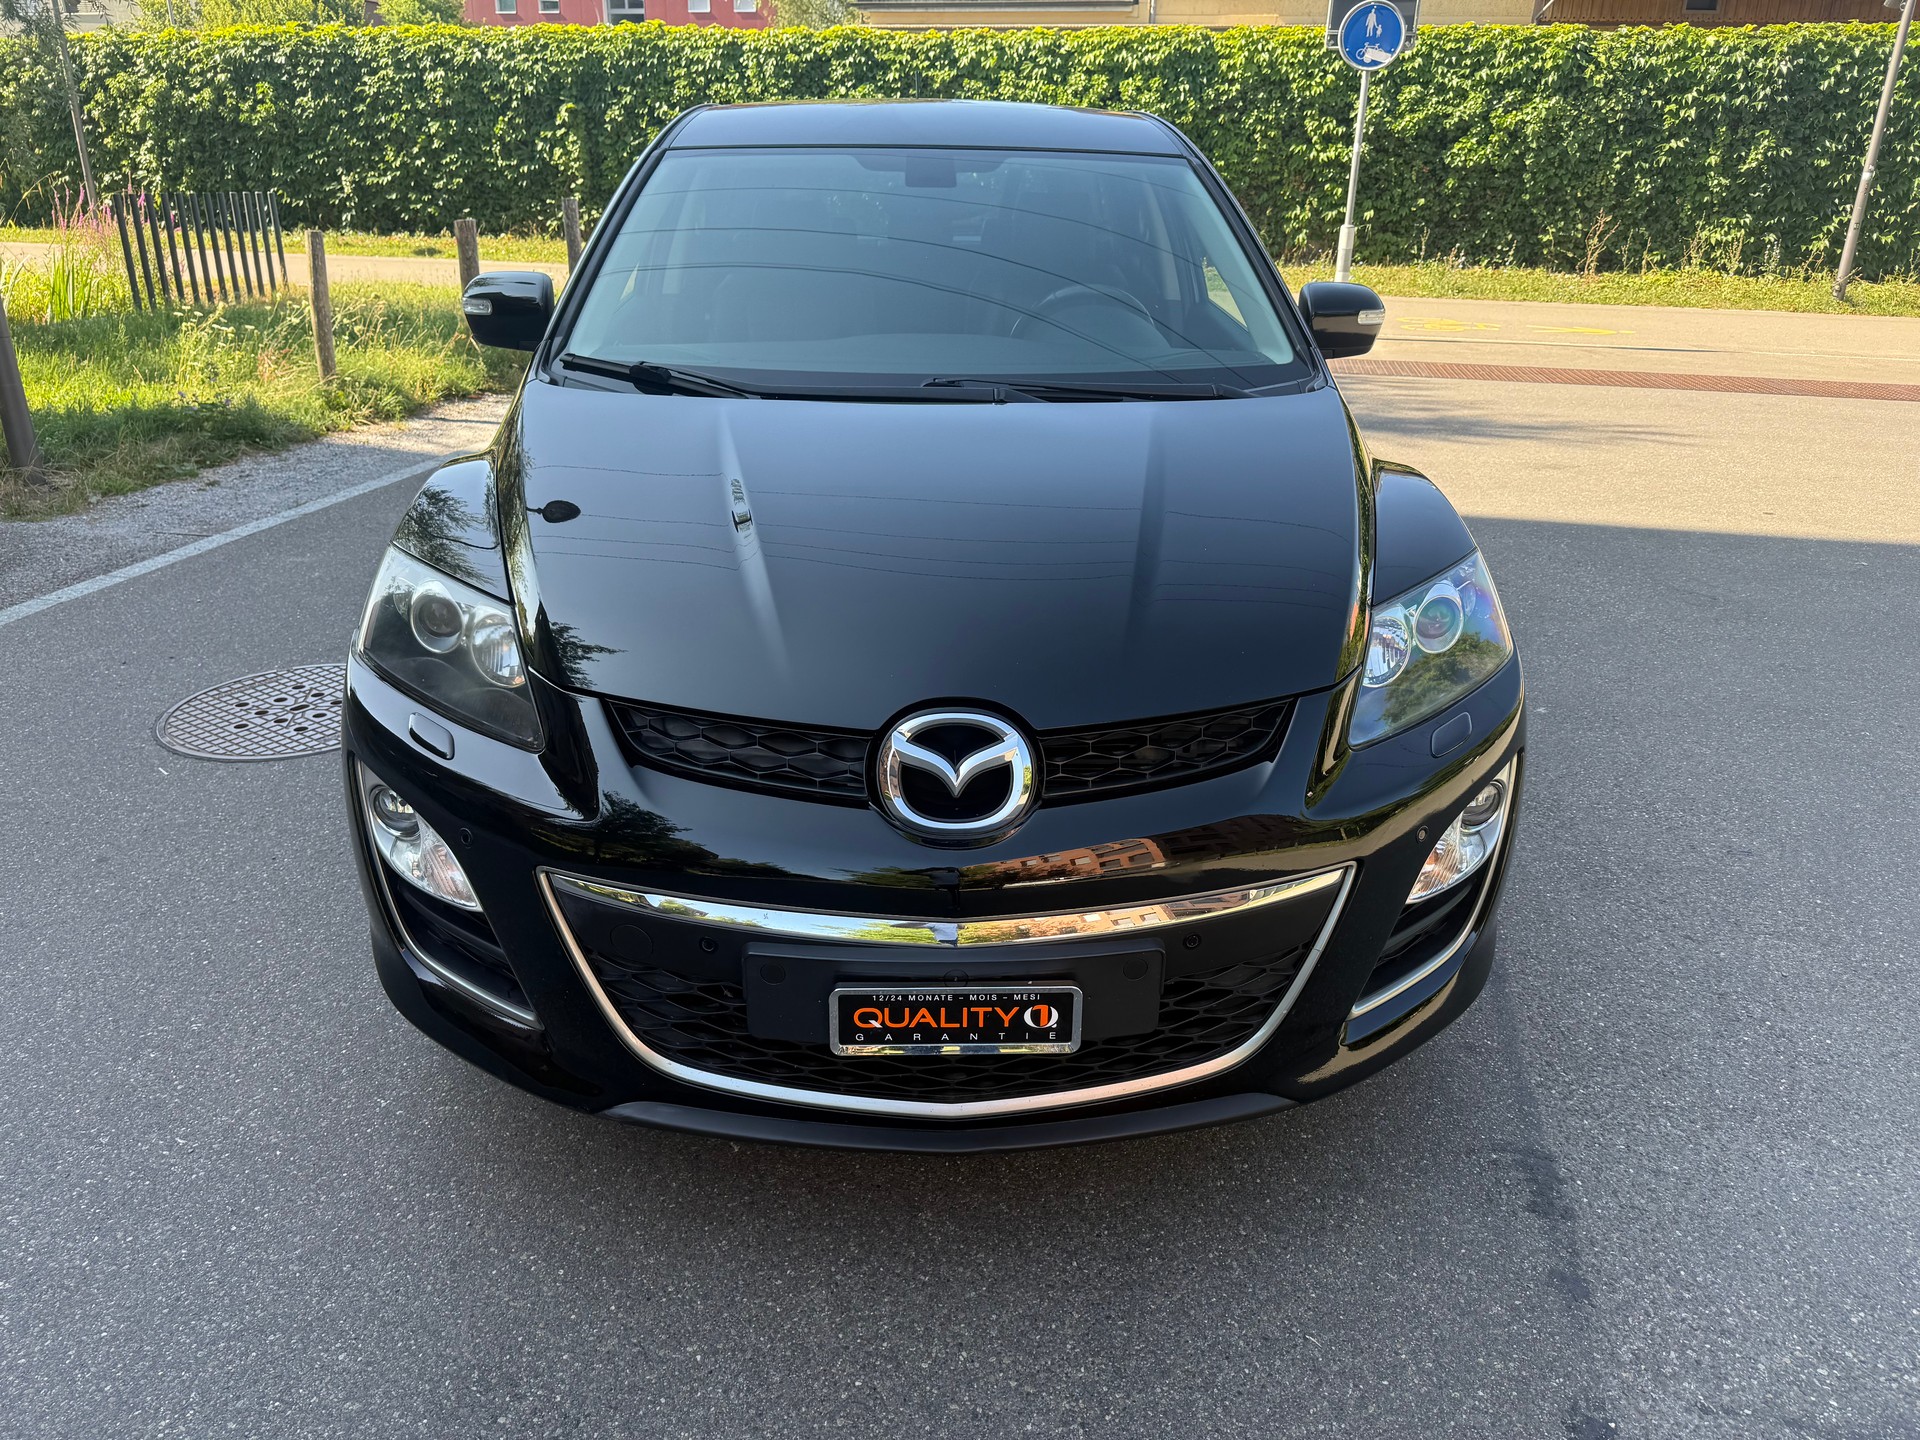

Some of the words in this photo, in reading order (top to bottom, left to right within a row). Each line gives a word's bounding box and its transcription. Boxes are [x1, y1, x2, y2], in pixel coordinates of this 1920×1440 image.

[872, 993, 902, 1003] 12/24
[908, 993, 953, 1003] MONATE
[969, 993, 997, 1003] MOIS
[1013, 993, 1040, 1003] MESI
[853, 1007, 1020, 1029] QUALITY
[855, 1031, 1056, 1042] GARANTIE
